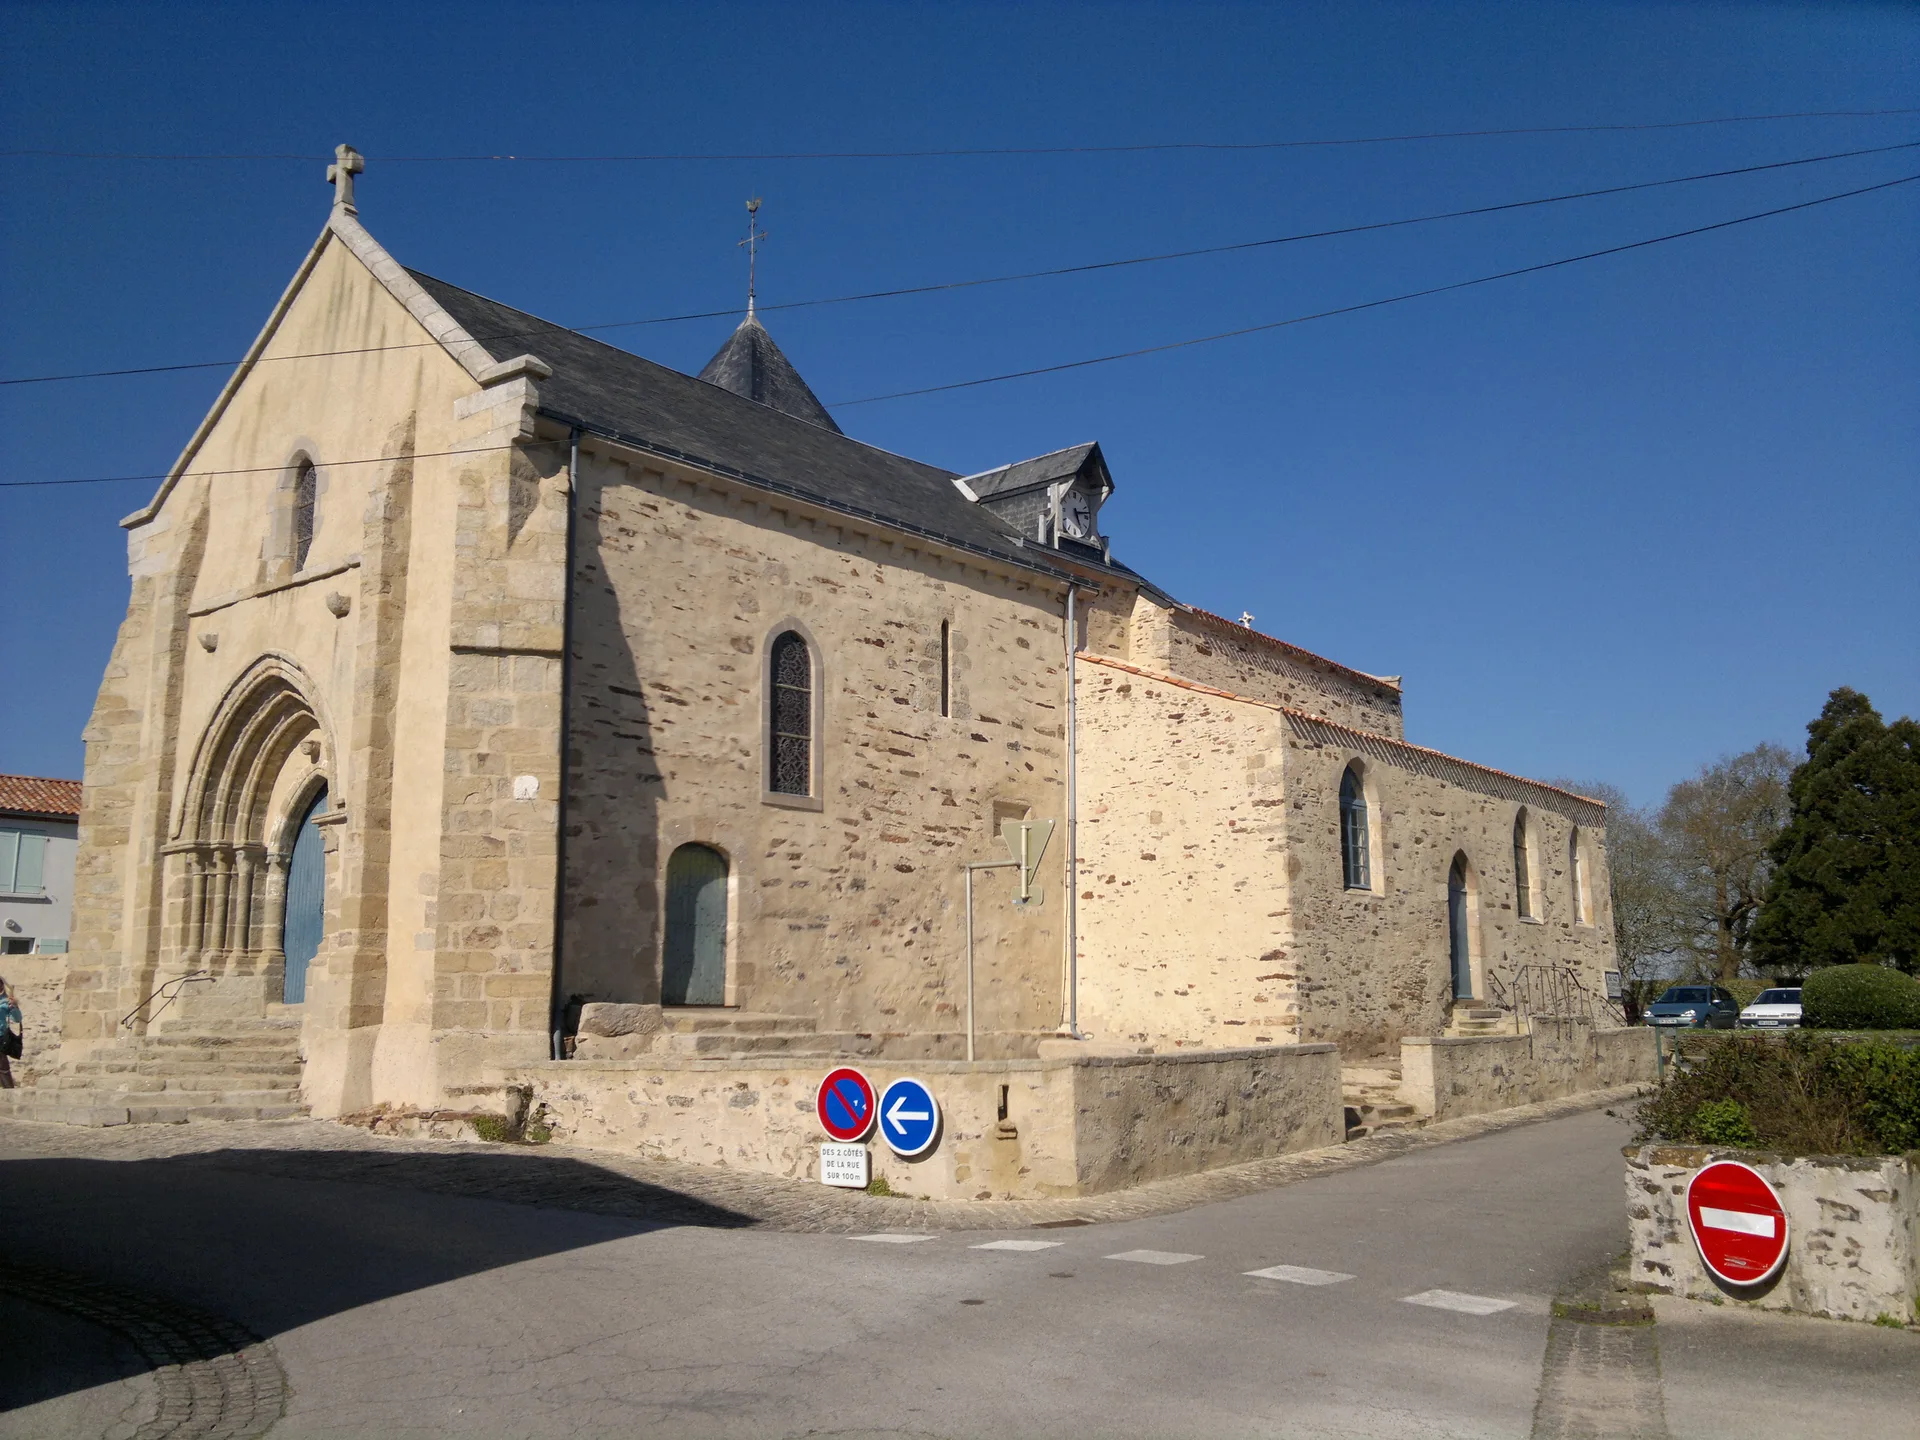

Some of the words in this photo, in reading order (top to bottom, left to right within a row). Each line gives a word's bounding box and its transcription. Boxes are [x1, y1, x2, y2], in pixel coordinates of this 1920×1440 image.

[822, 1148, 835, 1156] DES
[843, 1148, 864, 1157] CÔTÉS
[826, 1160, 835, 1168] DE
[846, 1161, 860, 1169] RUE
